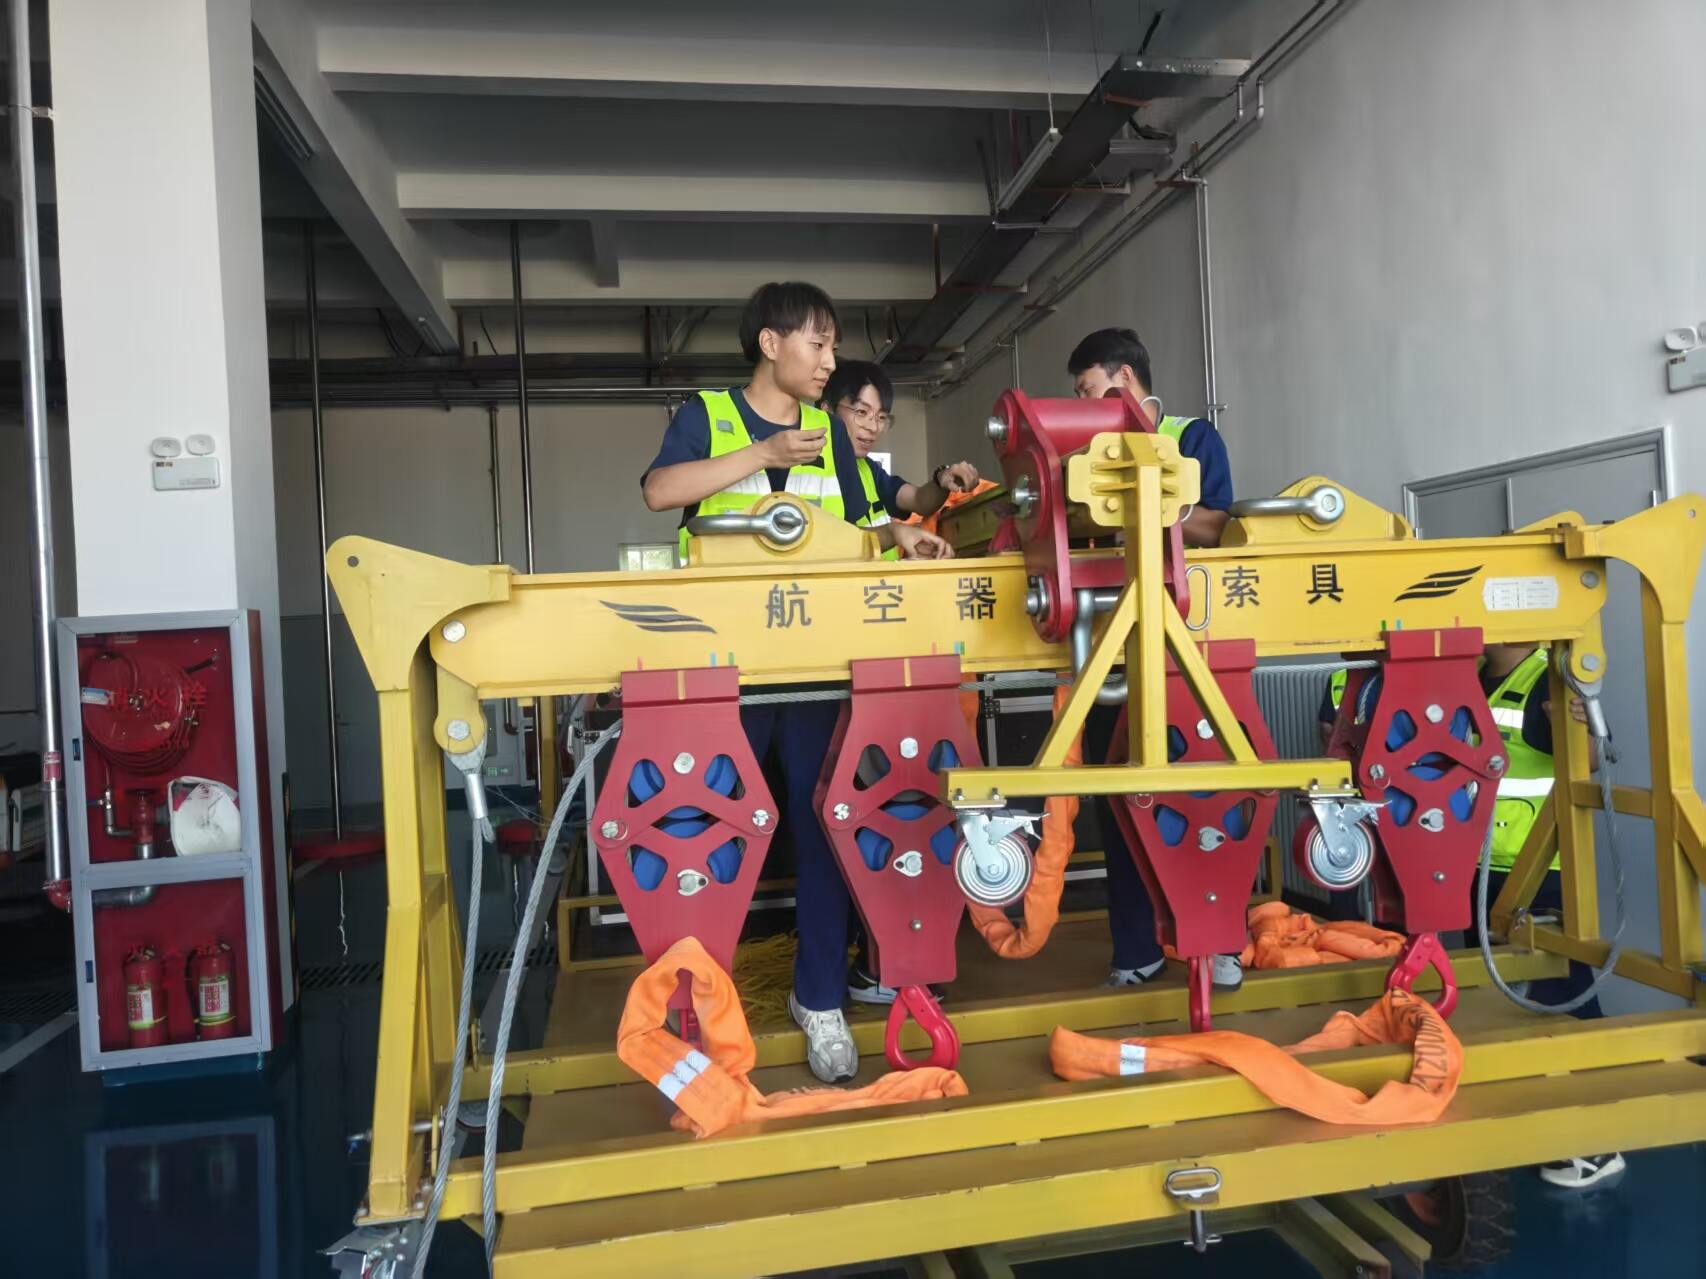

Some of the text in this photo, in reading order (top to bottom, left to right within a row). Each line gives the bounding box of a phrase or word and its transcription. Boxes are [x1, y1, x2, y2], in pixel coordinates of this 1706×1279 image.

[766, 563, 1344, 629] 航空器 索具
